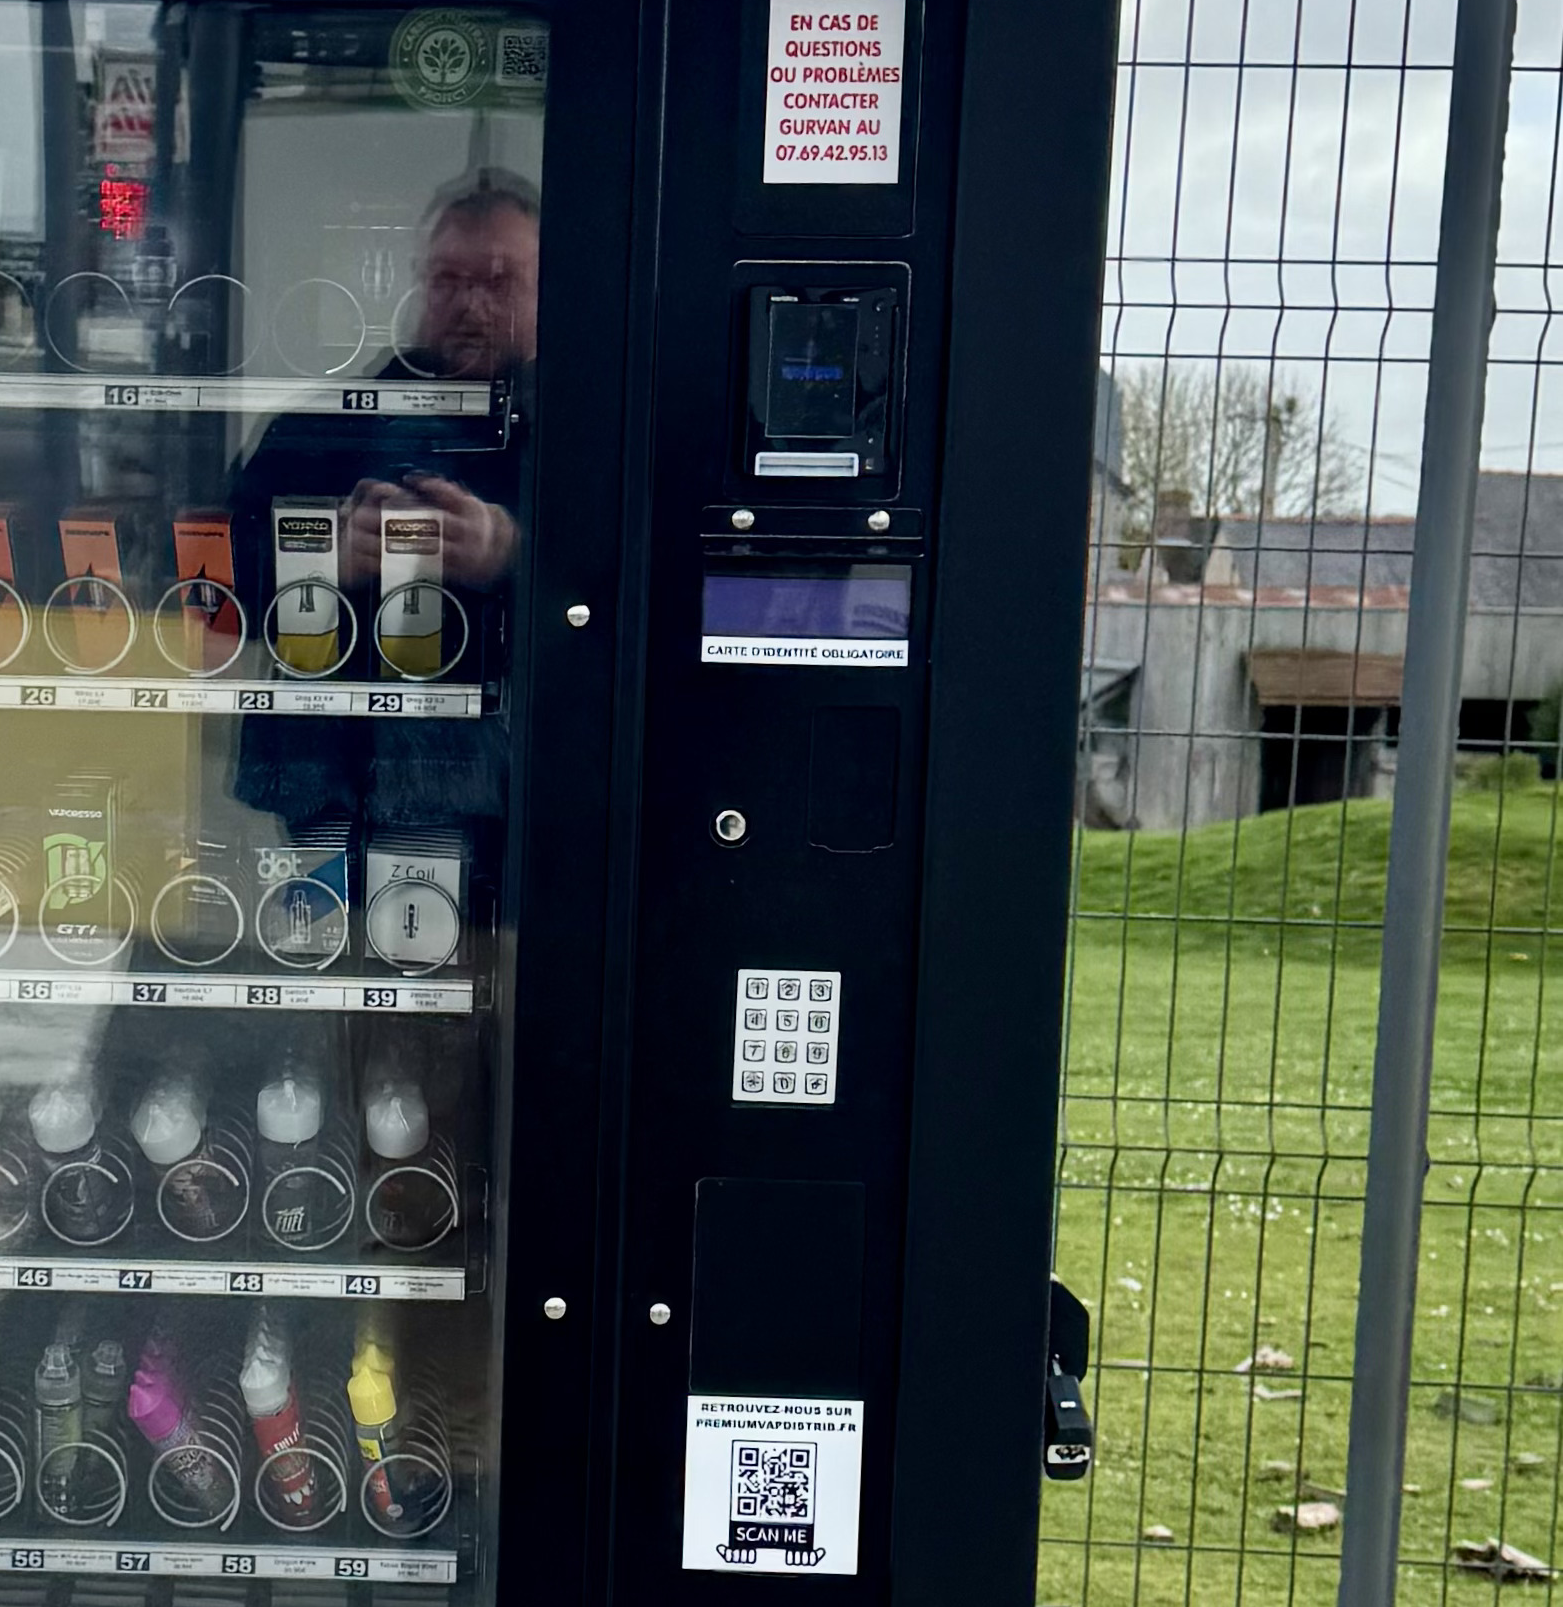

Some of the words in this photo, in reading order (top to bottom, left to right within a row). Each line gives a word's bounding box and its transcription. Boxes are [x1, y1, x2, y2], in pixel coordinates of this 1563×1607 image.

[790, 14, 813, 31] EN
[818, 14, 851, 31] CAS
[857, 14, 879, 31] DE
[785, 41, 882, 57] QUESTIONS
[770, 66, 797, 83] OU
[802, 61, 900, 83] PROBLÈMES
[783, 93, 879, 109] CONTACTER
[779, 119, 851, 135] GURVAN
[856, 119, 880, 135] AU
[775, 144, 888, 161] 07.69.42.95.13
[108, 387, 138, 404] 16
[346, 391, 375, 409] 18
[707, 645, 748, 657] CARTE
[821, 648, 904, 659] OBLIGATOIRE
[24, 688, 54, 704] 26
[136, 691, 166, 707] 27
[240, 693, 270, 709] 28
[370, 695, 401, 711] 29
[405, 865, 436, 881] Coil
[20, 981, 50, 998] 36
[136, 984, 165, 1001] 37
[250, 987, 279, 1003] 38
[366, 990, 396, 1006] 39
[19, 1269, 49, 1285] 46
[120, 1271, 150, 1287] 47
[232, 1274, 261, 1290] 48
[348, 1278, 377, 1294] 49
[826, 1406, 853, 1416] SUR
[735, 1526, 779, 1543] SCAN
[784, 1528, 808, 1543] ME
[14, 1551, 42, 1567] 56
[120, 1554, 148, 1570] 57
[224, 1557, 253, 1573] 58
[338, 1559, 367, 1576] 59
